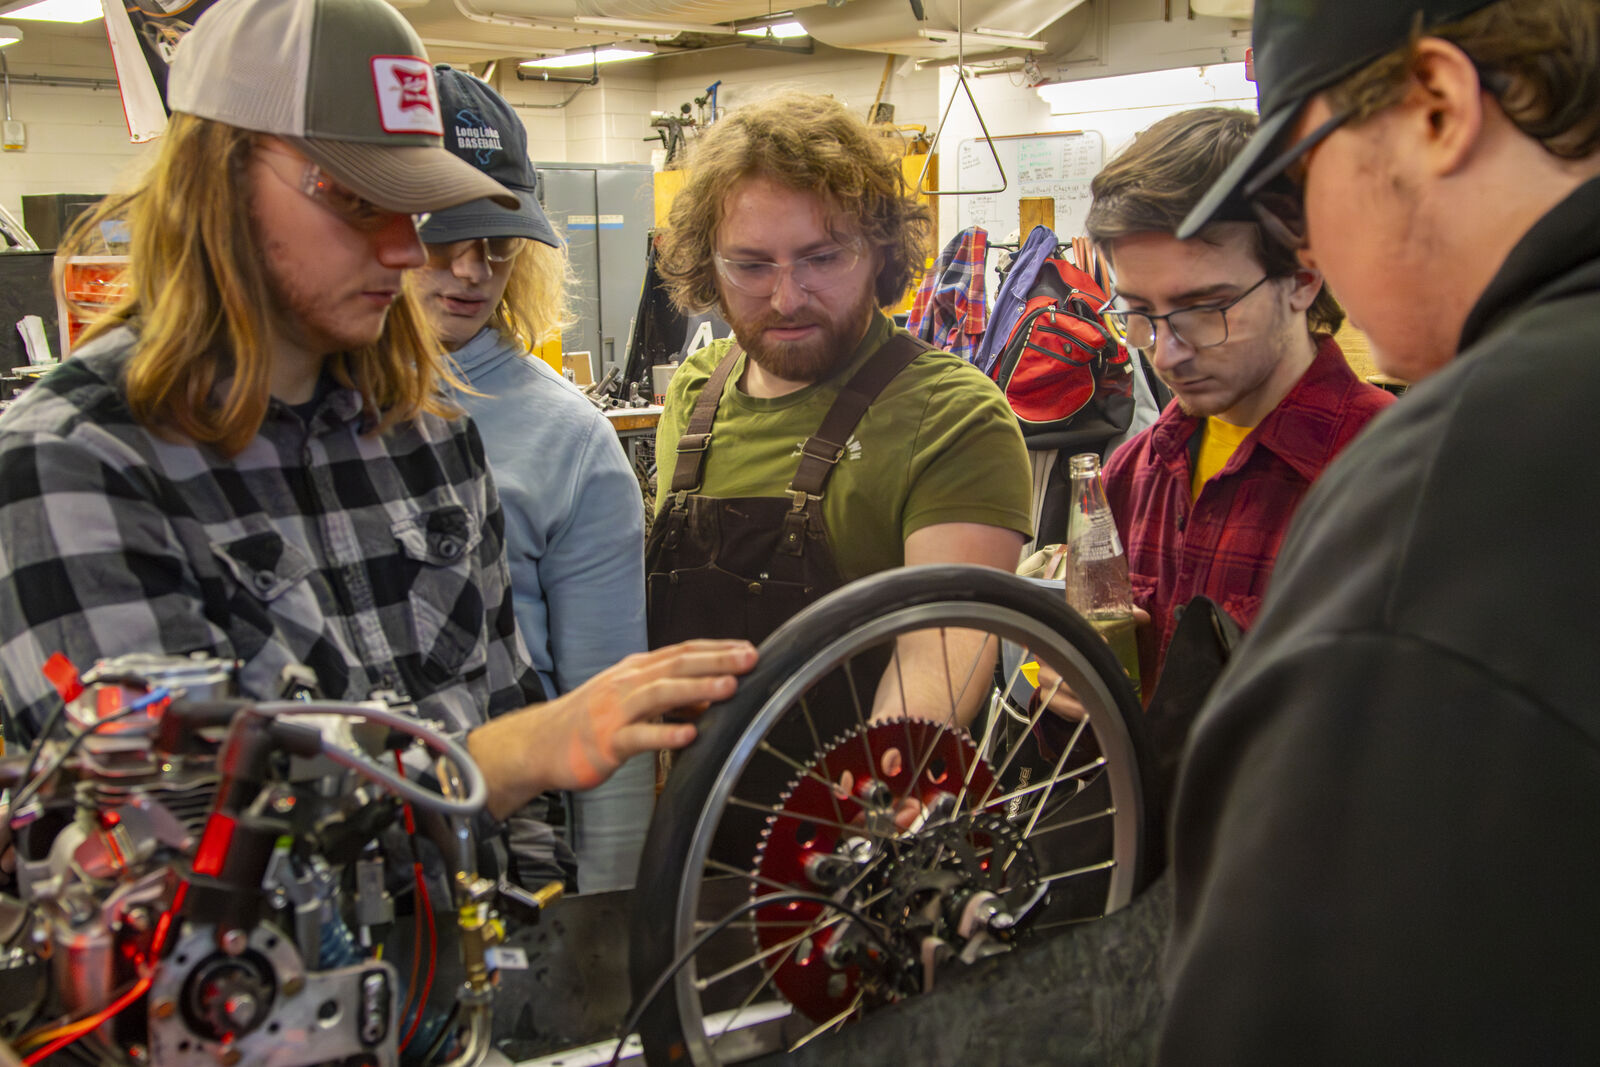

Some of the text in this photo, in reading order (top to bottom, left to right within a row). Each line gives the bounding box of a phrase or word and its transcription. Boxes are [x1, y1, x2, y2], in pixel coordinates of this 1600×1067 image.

[455, 125, 500, 139] Long Lake
[457, 137, 504, 150] BASEBALL
